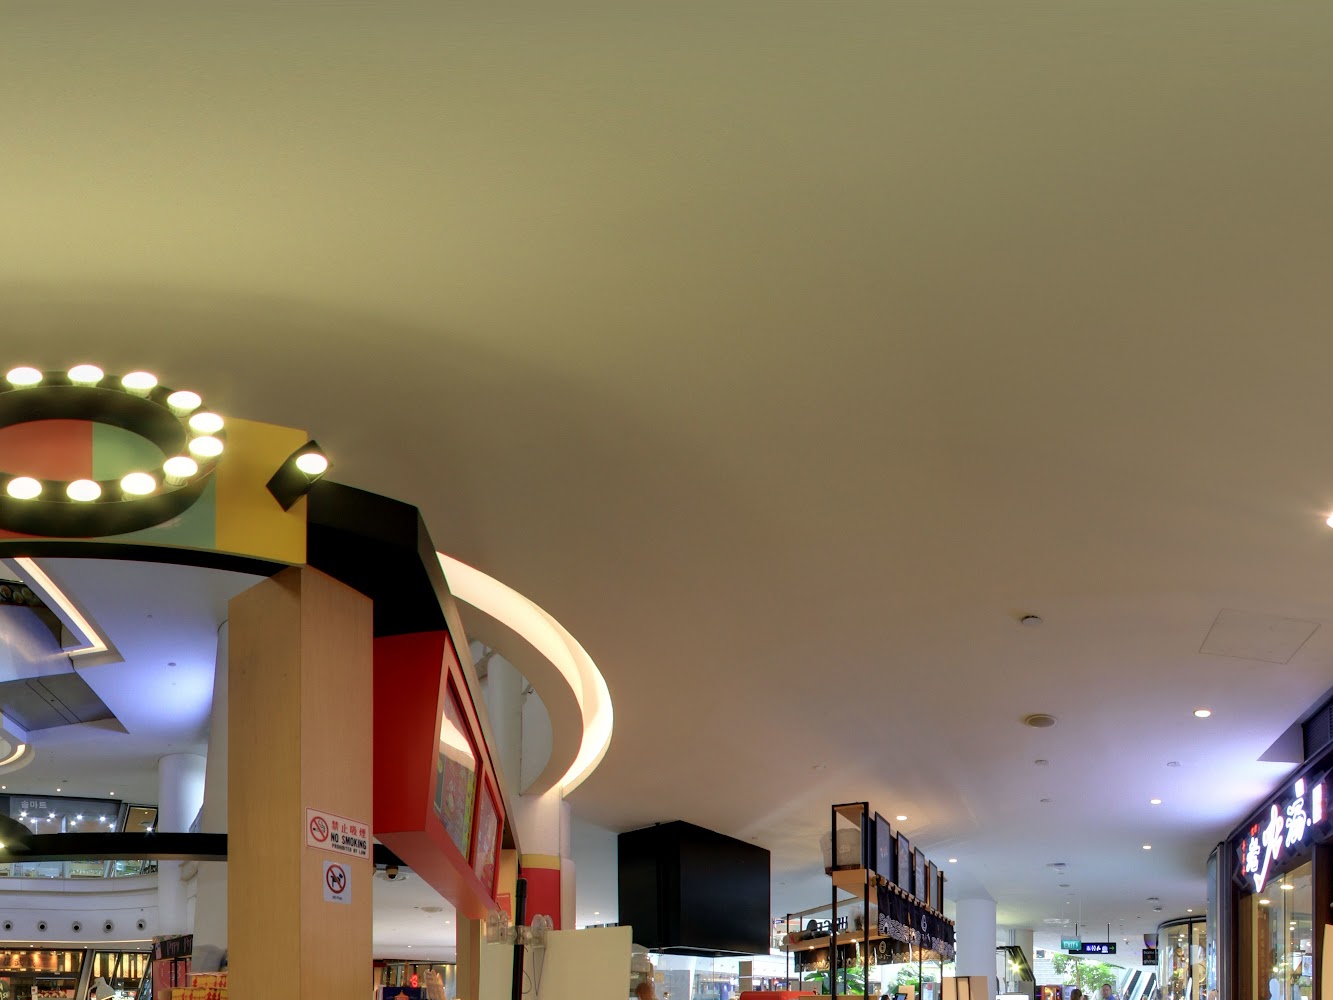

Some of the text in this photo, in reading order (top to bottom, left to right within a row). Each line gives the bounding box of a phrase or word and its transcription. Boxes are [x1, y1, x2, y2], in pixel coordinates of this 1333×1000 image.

[331, 820, 366, 839] 禁止吸煙
[331, 833, 367, 850] NO SMOKING
[332, 843, 352, 853] PROHIBITED
